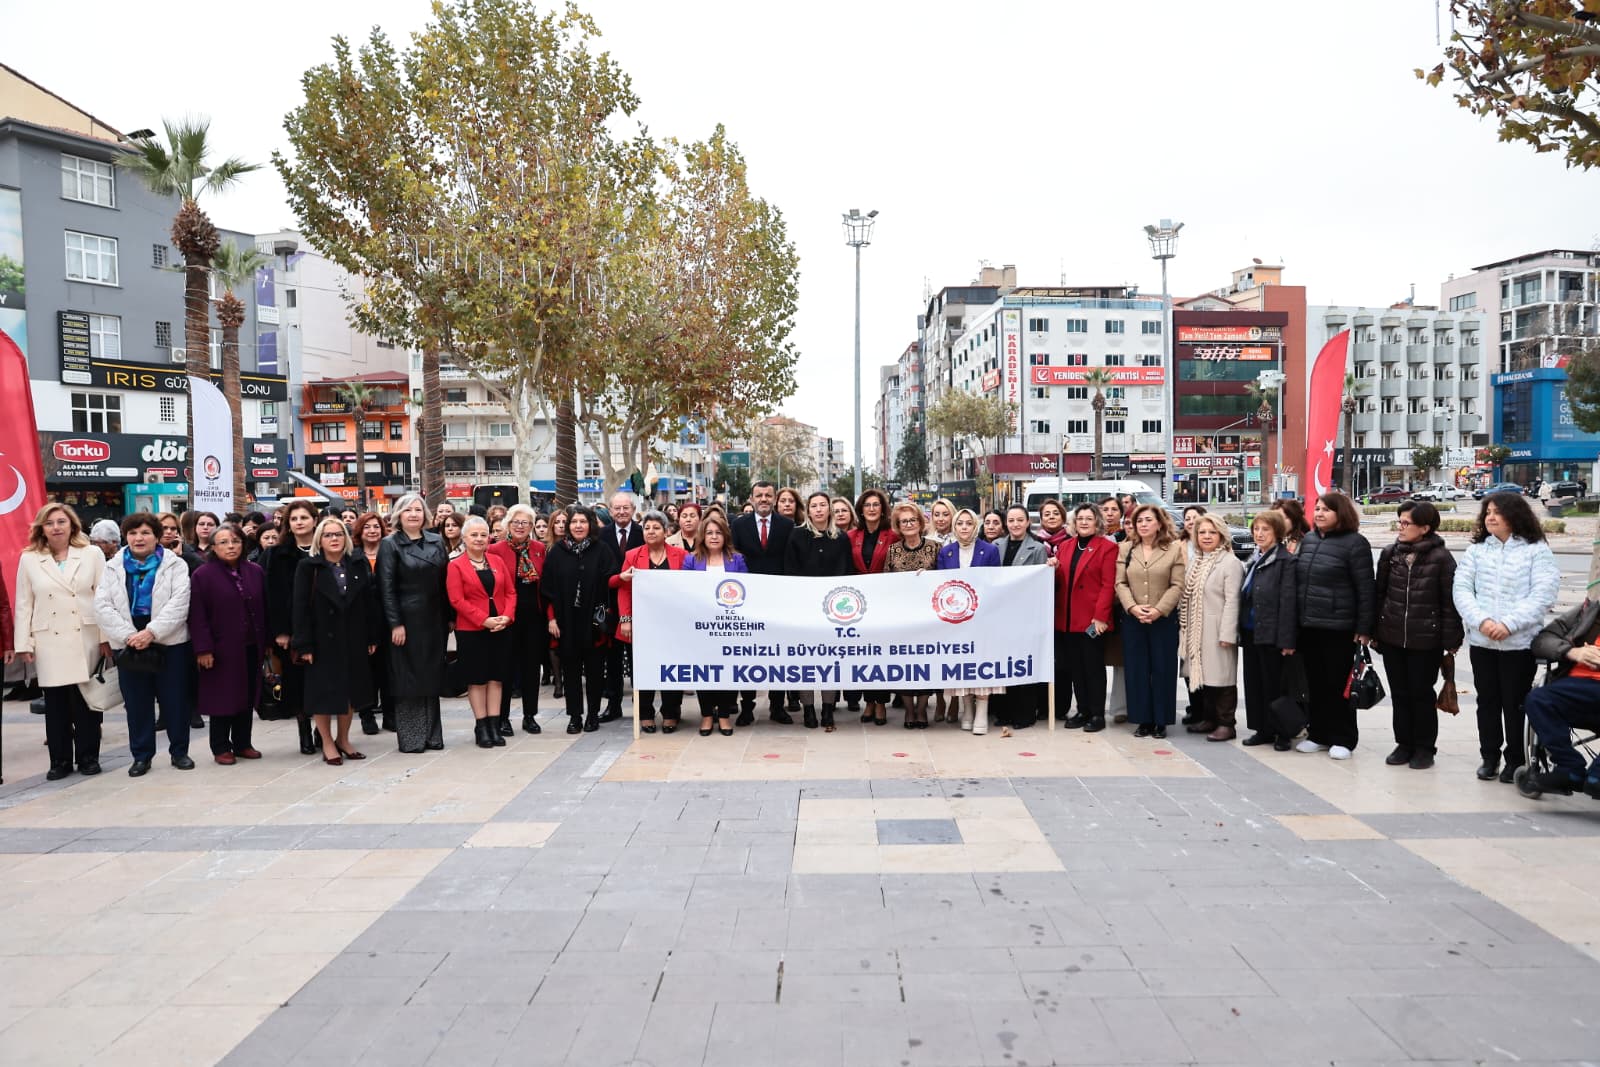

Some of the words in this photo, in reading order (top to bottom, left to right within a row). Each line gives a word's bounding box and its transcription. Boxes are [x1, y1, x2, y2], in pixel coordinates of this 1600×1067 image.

[59, 443, 104, 457] Torku
[835, 627, 860, 638] T.C.
[722, 644, 781, 657] DENİZLİ
[787, 643, 882, 659] BÜYÜKŞEHİR
[889, 641, 975, 656] BELEDİYESİ
[660, 664, 724, 683] KENT
[732, 661, 841, 683] KONSEYİ
[851, 663, 931, 683] KADIN
[942, 654, 1033, 680] MECLİSİ
